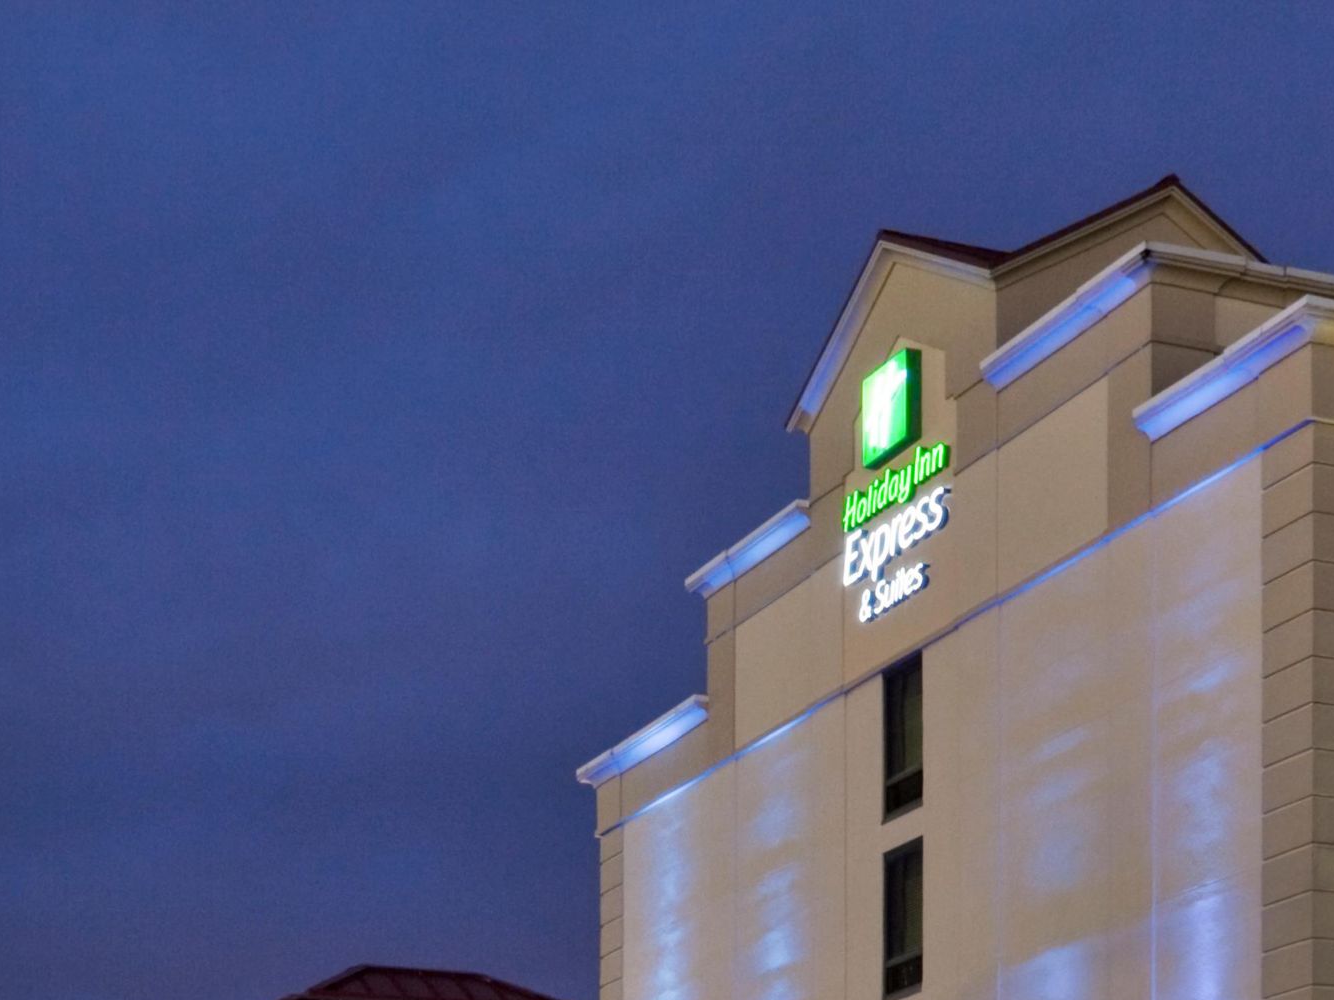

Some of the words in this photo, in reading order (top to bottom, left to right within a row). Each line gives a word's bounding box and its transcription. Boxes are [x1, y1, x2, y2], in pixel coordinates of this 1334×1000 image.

[843, 465, 912, 533] Holiday
[913, 442, 947, 486] Inn
[843, 486, 945, 587] Express
[858, 588, 874, 623] &
[873, 562, 925, 614] Suites
